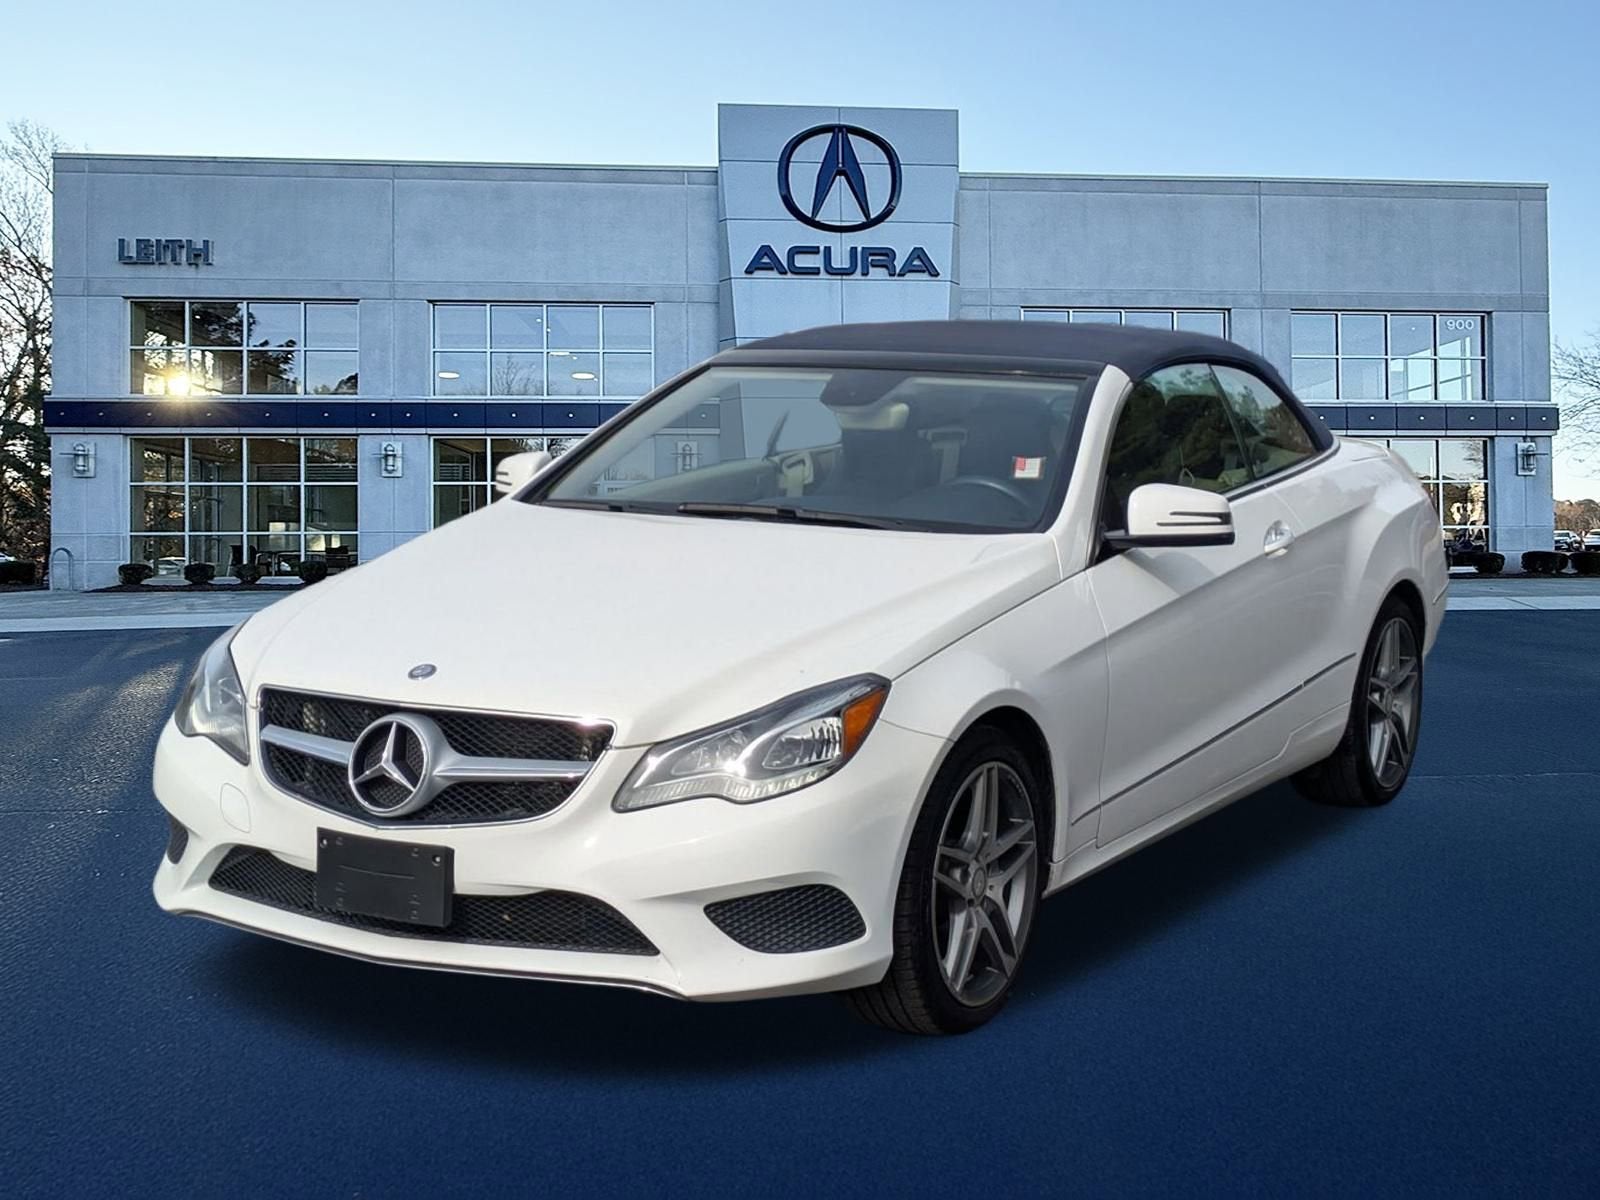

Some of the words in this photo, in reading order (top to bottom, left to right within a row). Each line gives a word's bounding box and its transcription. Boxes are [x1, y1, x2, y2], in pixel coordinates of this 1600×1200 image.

[118, 238, 212, 265] LEITH
[744, 244, 940, 277] ACURA
[1446, 319, 1474, 330] 900
